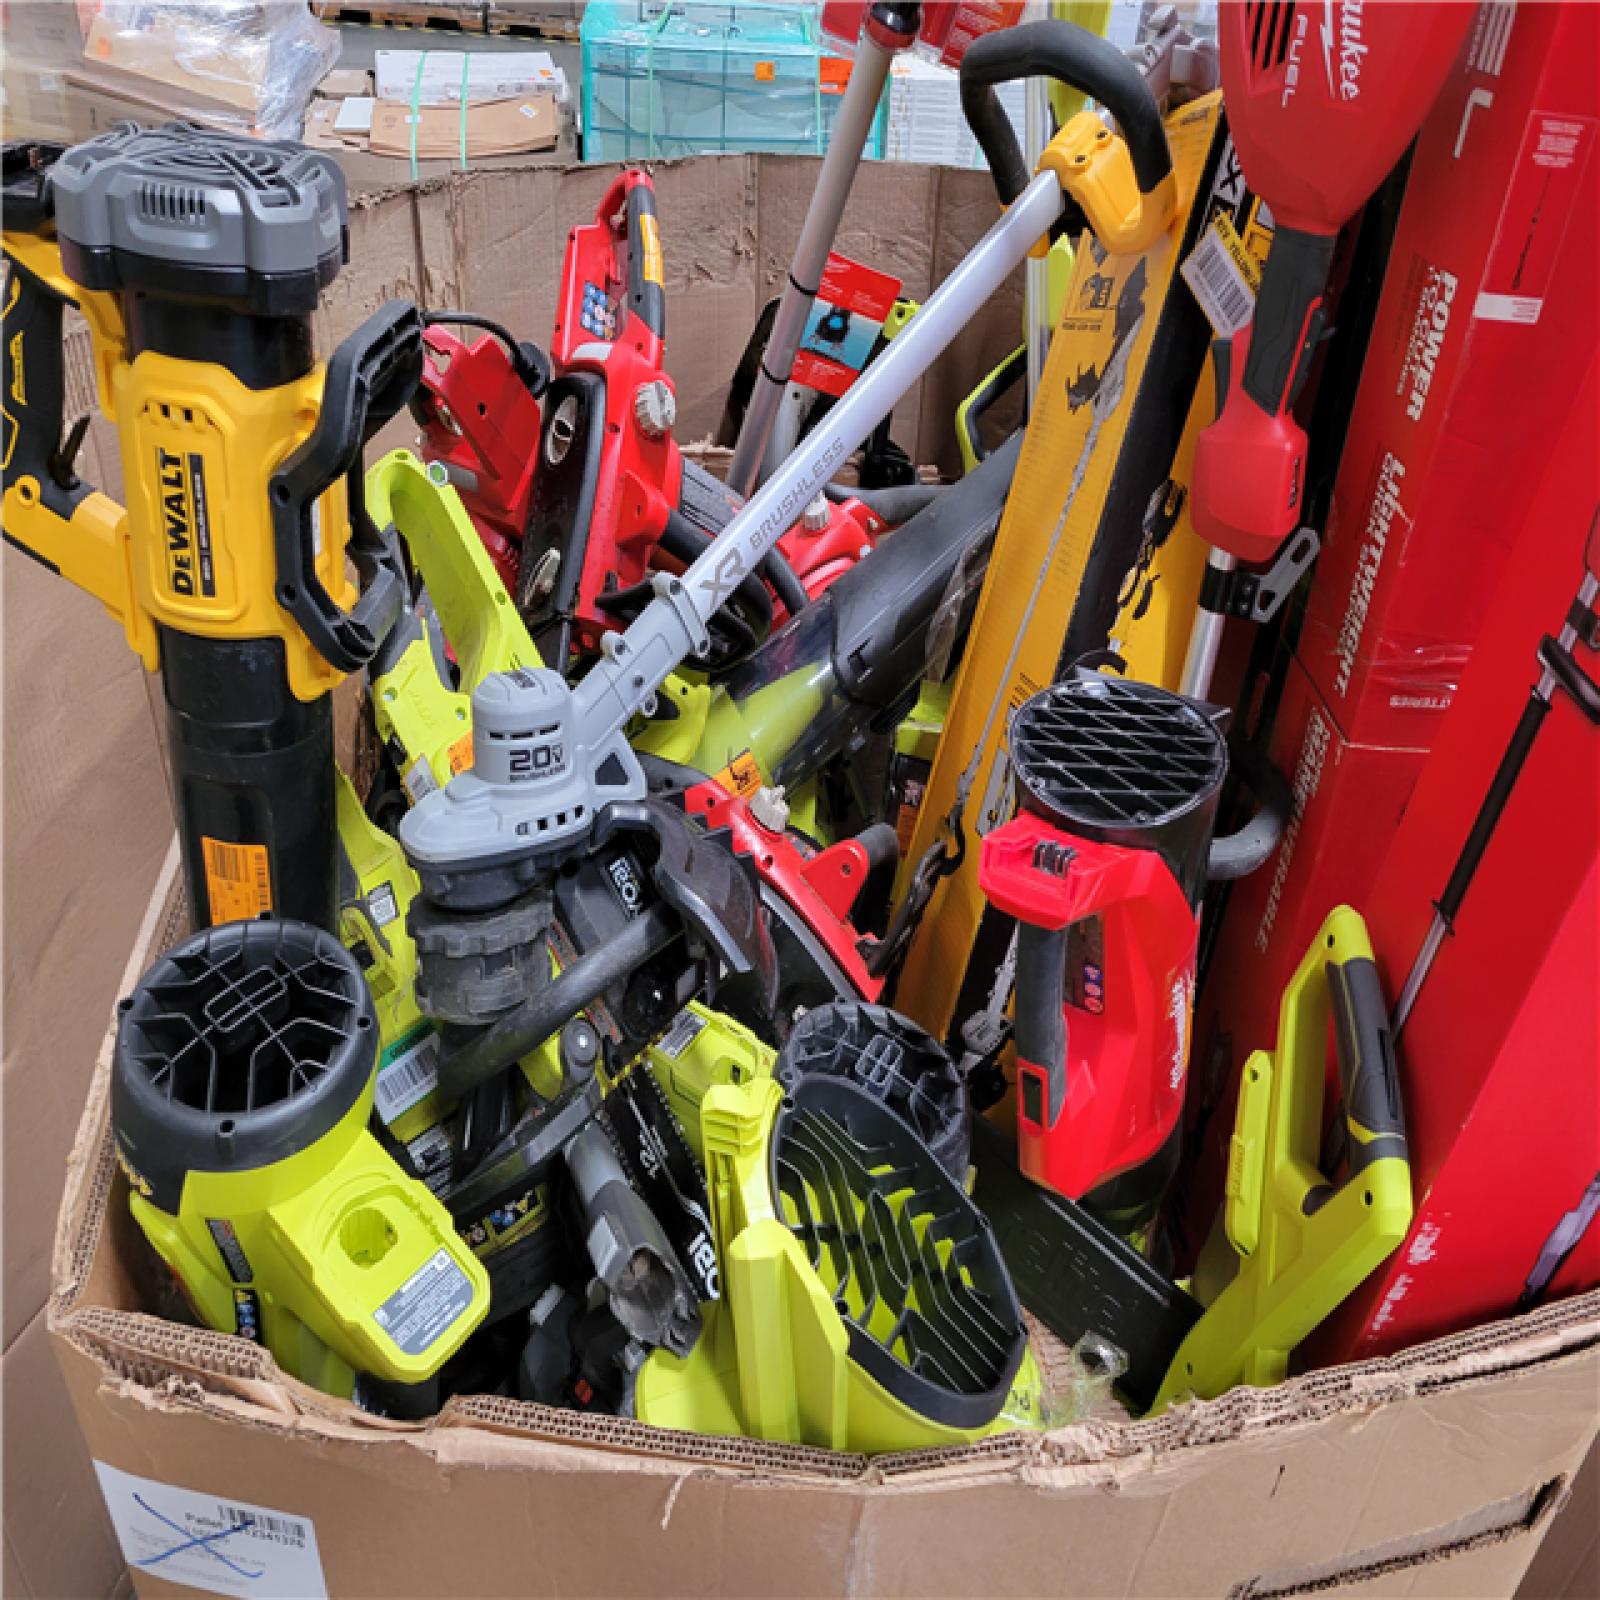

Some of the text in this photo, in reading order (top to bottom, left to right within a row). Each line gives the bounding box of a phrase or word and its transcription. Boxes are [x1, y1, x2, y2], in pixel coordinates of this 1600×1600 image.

[1282, 14, 1308, 108] FUEL
[1407, 270, 1458, 422] POWER
[700, 546, 747, 607] XR
[751, 437, 843, 547] BRUSHLESS
[610, 857, 641, 920] YOBI
